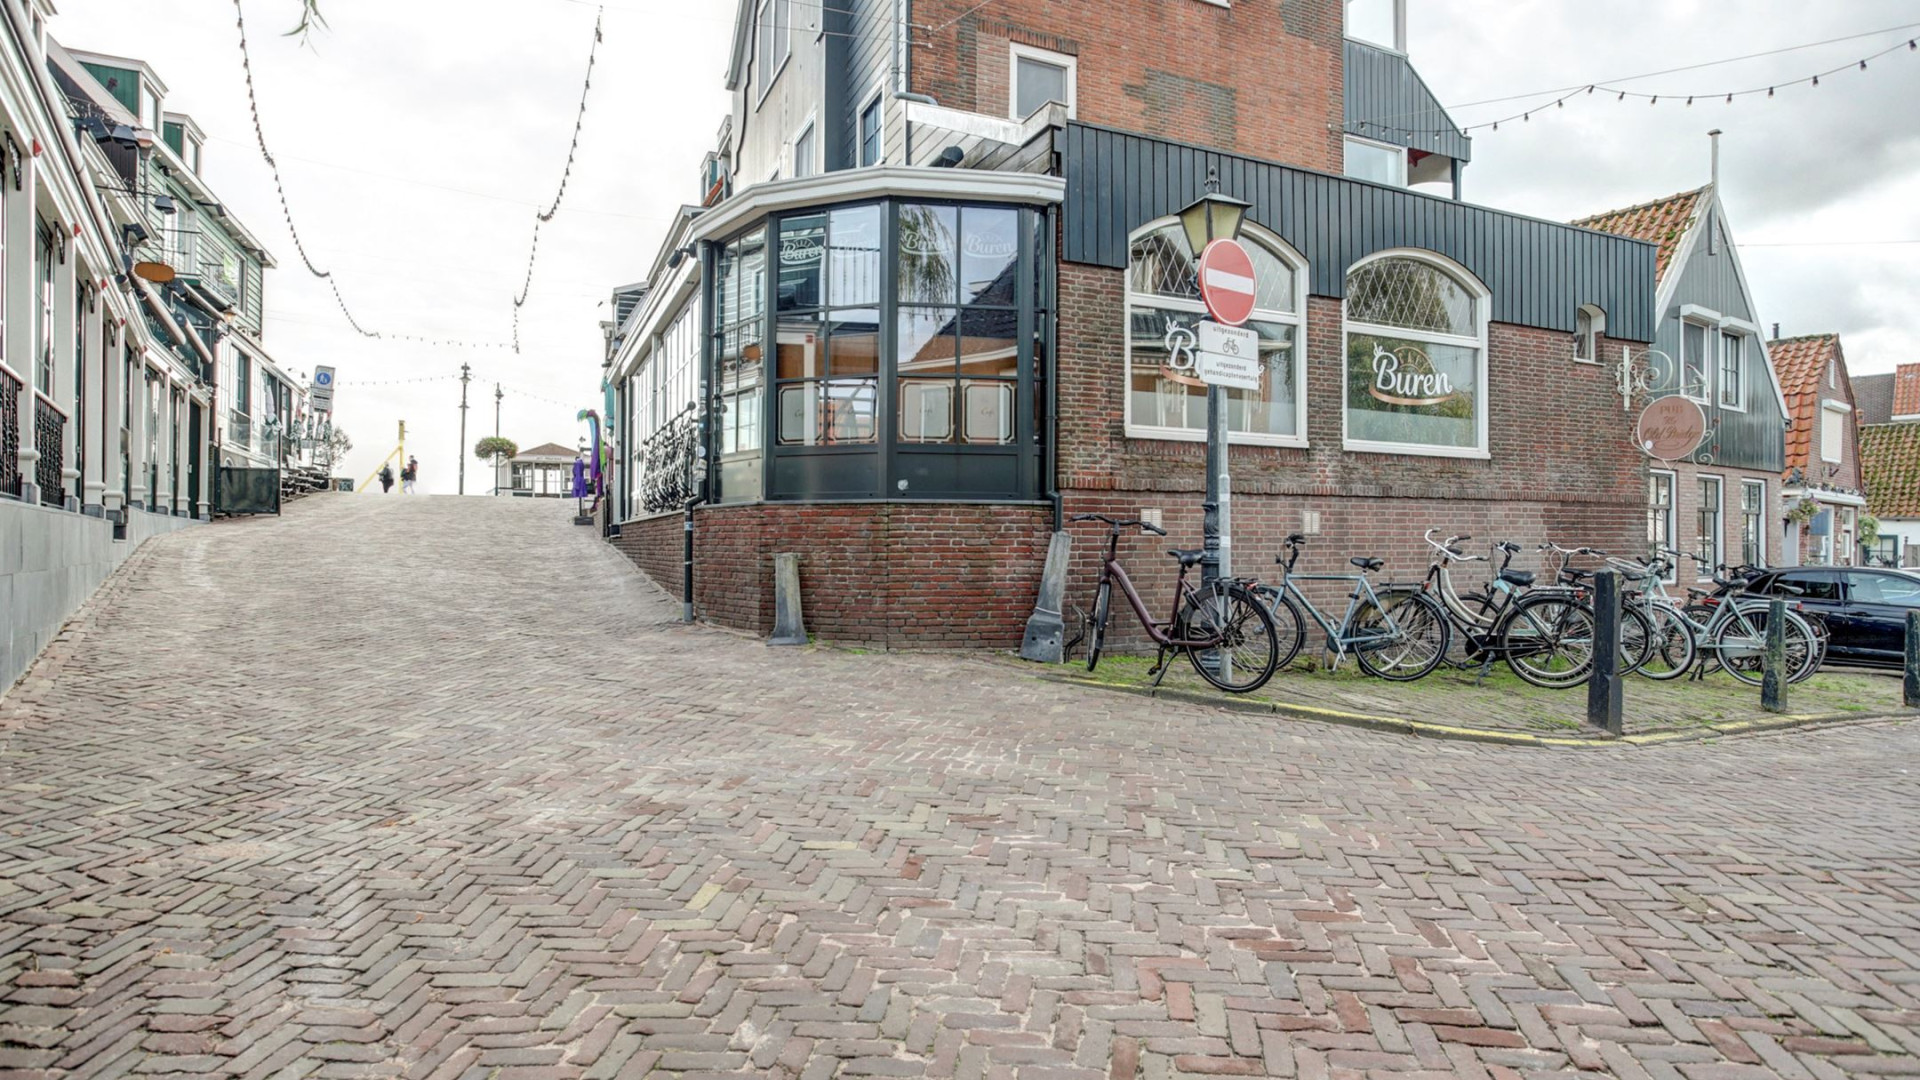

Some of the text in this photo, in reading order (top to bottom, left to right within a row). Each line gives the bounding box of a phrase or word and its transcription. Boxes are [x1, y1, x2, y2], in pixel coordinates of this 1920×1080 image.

[1212, 326, 1250, 339] uitgezonderd
[1216, 361, 1248, 372] uitgezonderd
[1372, 352, 1453, 396] Buren
[1660, 405, 1684, 415] PUB
[1643, 426, 1666, 441] Old
